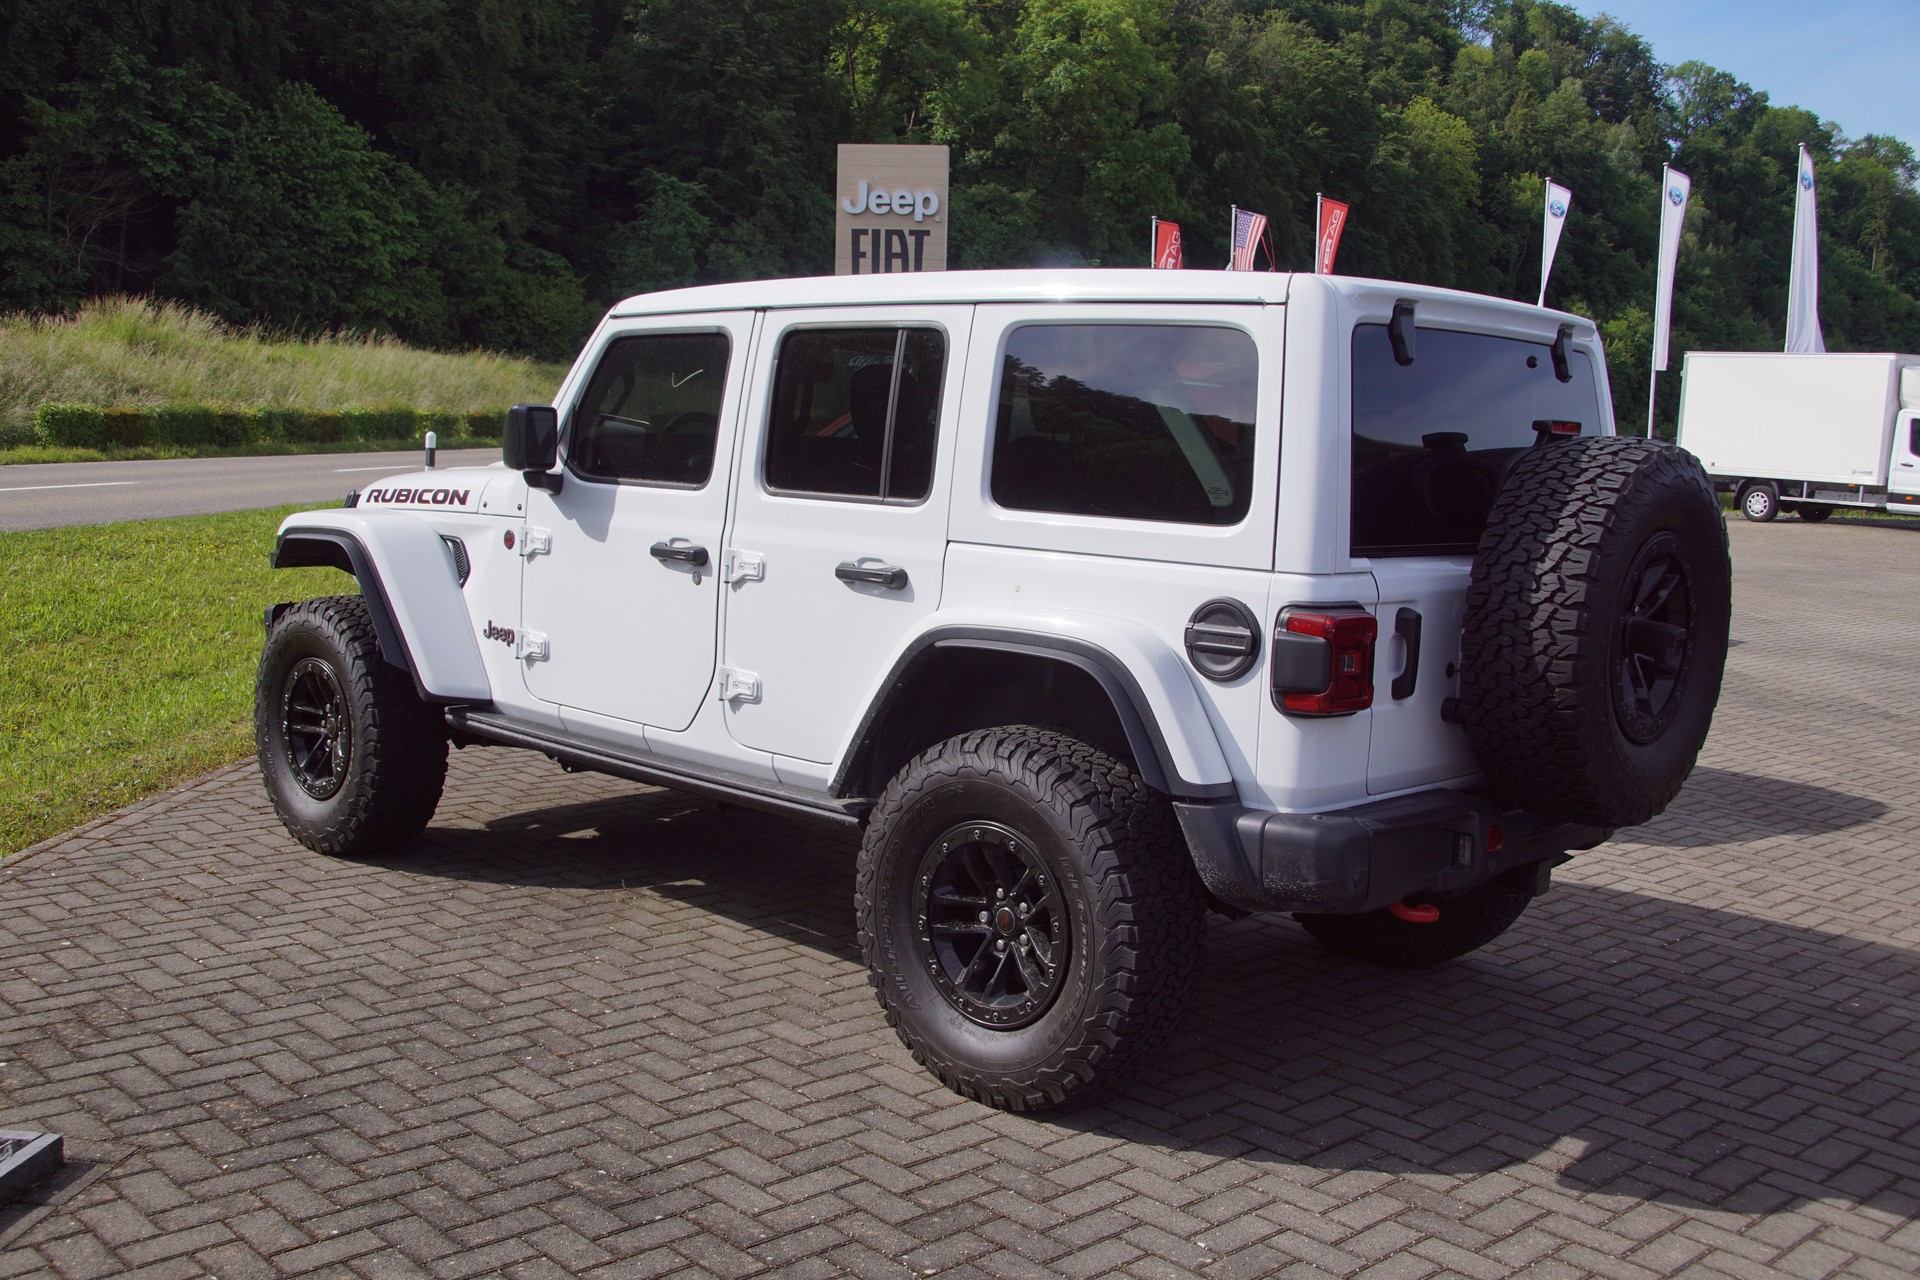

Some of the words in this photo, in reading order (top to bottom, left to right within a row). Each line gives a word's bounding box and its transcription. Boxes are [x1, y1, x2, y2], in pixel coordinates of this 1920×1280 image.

[842, 180, 940, 222] Jeep
[1330, 209, 1341, 237] AG
[851, 228, 931, 274] FIAT
[366, 488, 471, 506] RUBICON
[483, 619, 516, 647] Jeep
